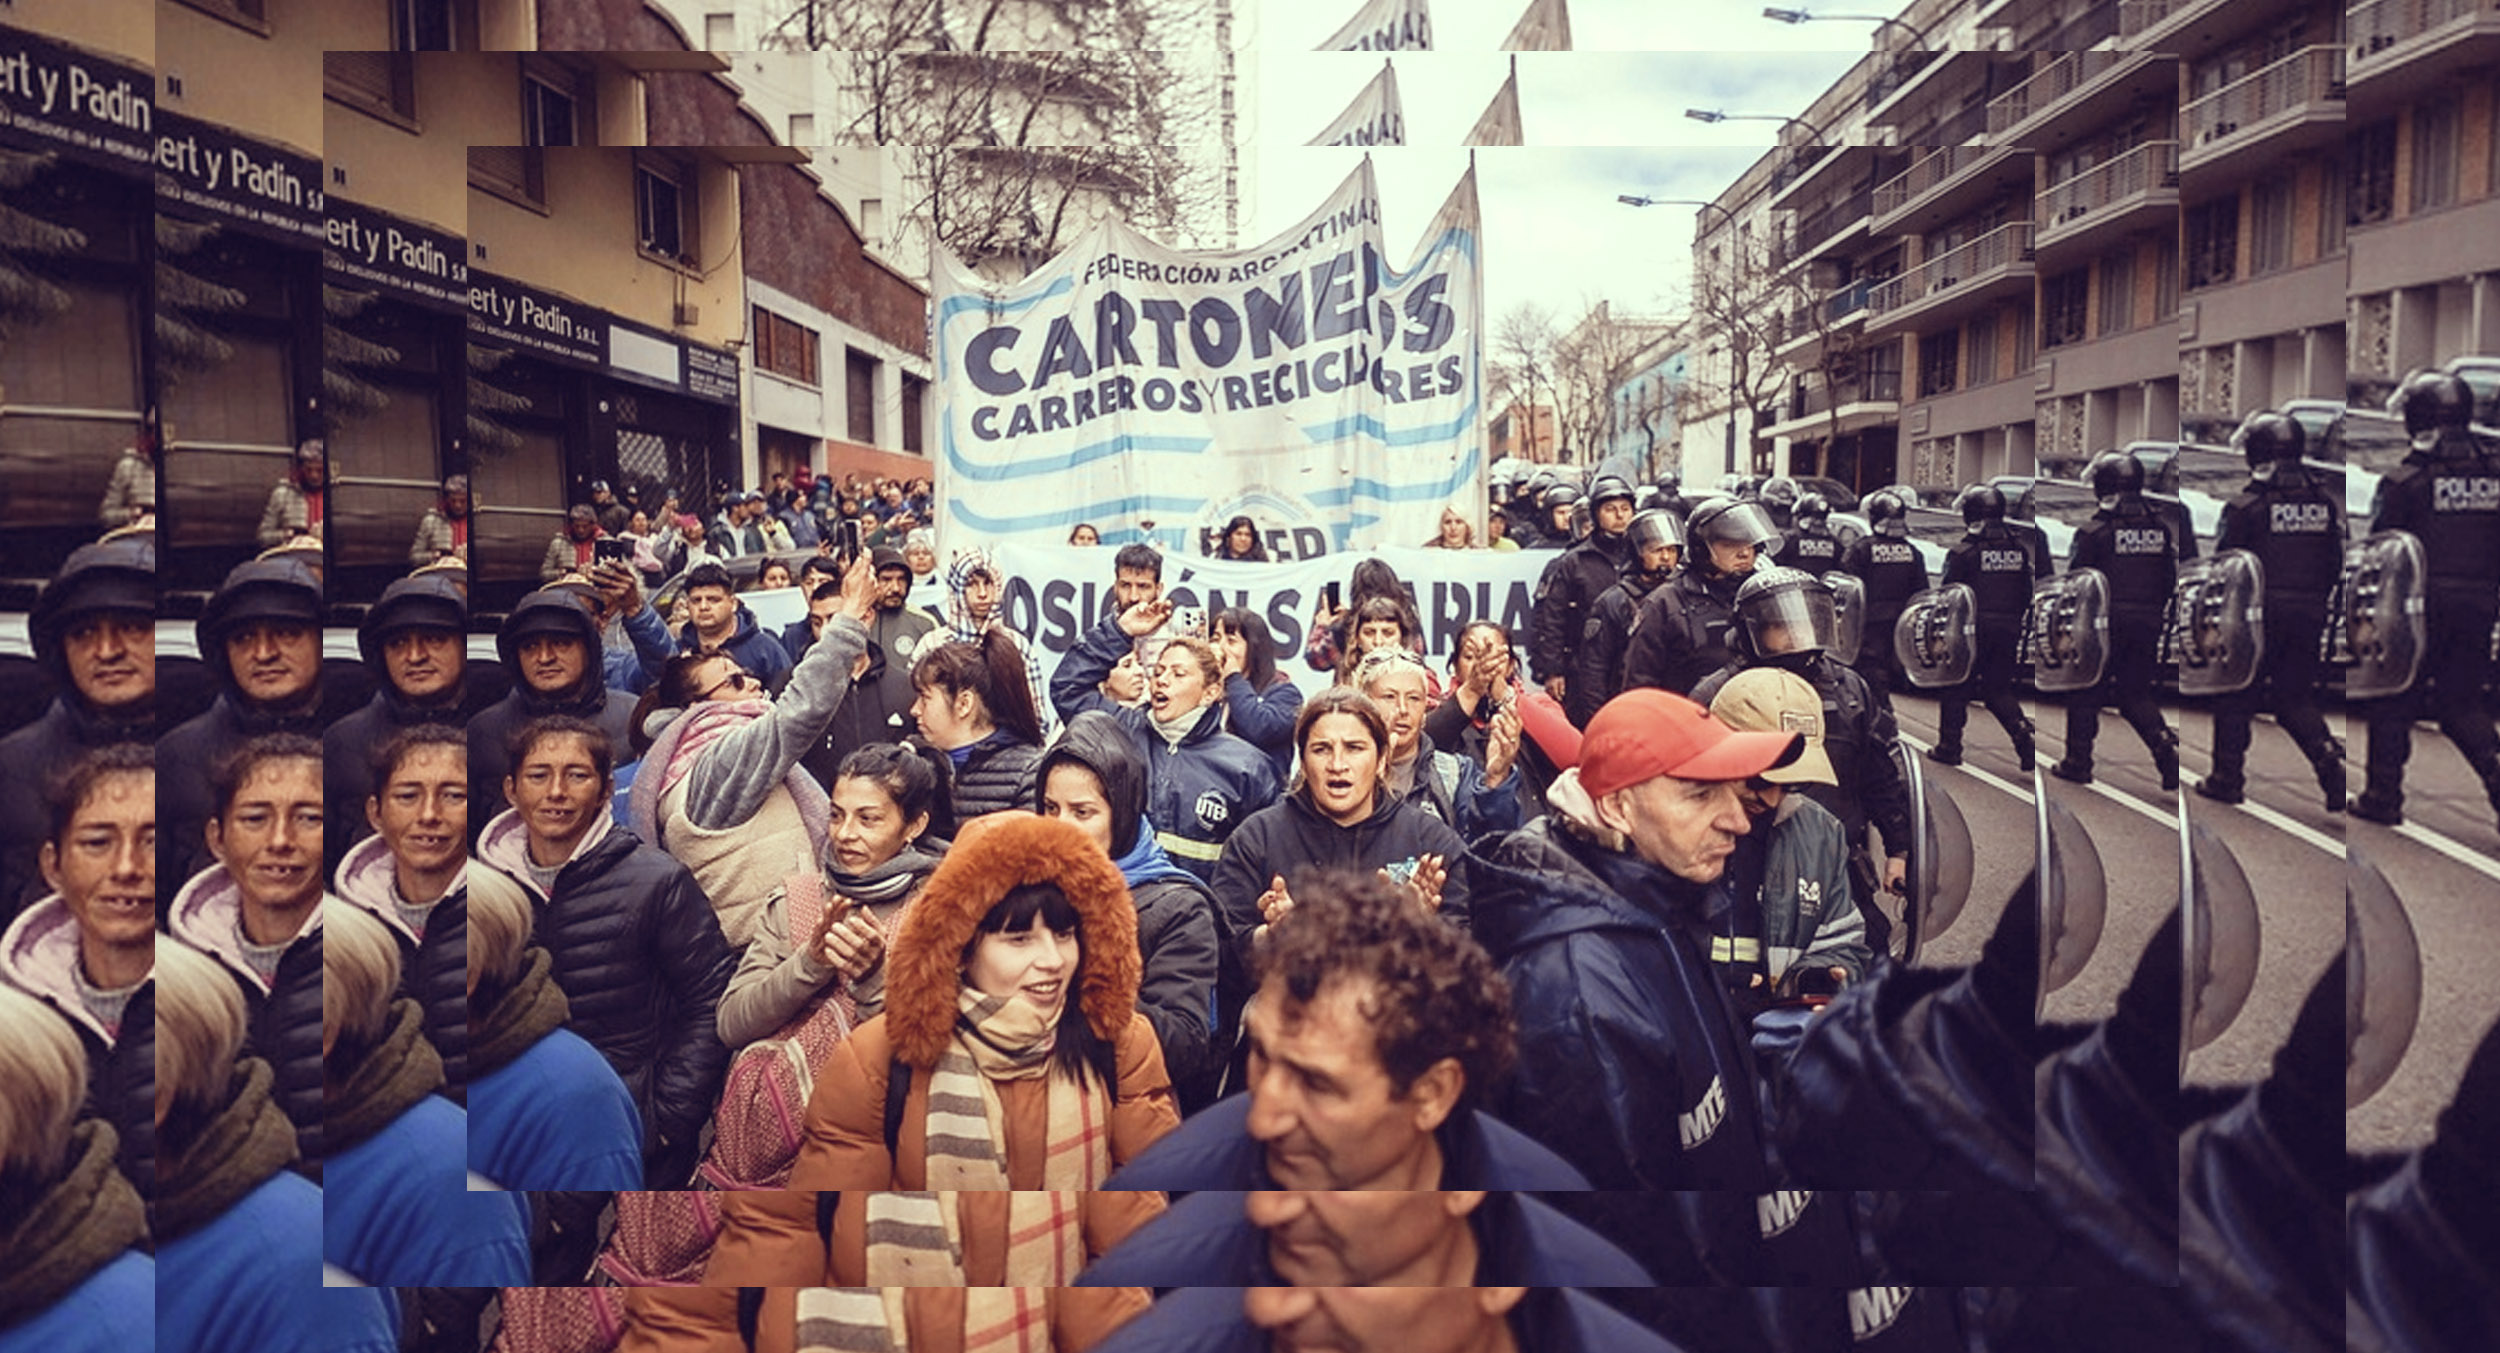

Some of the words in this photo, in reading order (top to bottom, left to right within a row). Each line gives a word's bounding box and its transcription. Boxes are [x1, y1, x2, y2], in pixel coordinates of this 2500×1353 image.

[0, 52, 33, 98] rt
[38, 67, 59, 114] y
[70, 66, 150, 132] Padin
[155, 136, 200, 177] ert
[204, 149, 222, 190] y
[231, 148, 301, 206] Padin
[323, 218, 361, 252] ert
[365, 229, 380, 264] y
[387, 228, 447, 278] Padin
[1084, 252, 1220, 285] FEDERACIÓN
[1228, 198, 1369, 283] ARGTINA
[467, 287, 499, 316] ert
[502, 296, 515, 326] y
[521, 296, 571, 338] Padin
[971, 375, 1203, 441] CARREROS
[1198, 377, 1220, 415] Y
[2433, 477, 2500, 498] POLICIA
[2271, 503, 2329, 520] POLICIA
[1799, 539, 1834, 550] POLICIA
[1871, 543, 1912, 556] POLICIA
[2115, 529, 2164, 544] POLICIA
[1981, 551, 2022, 563] POLICIA
